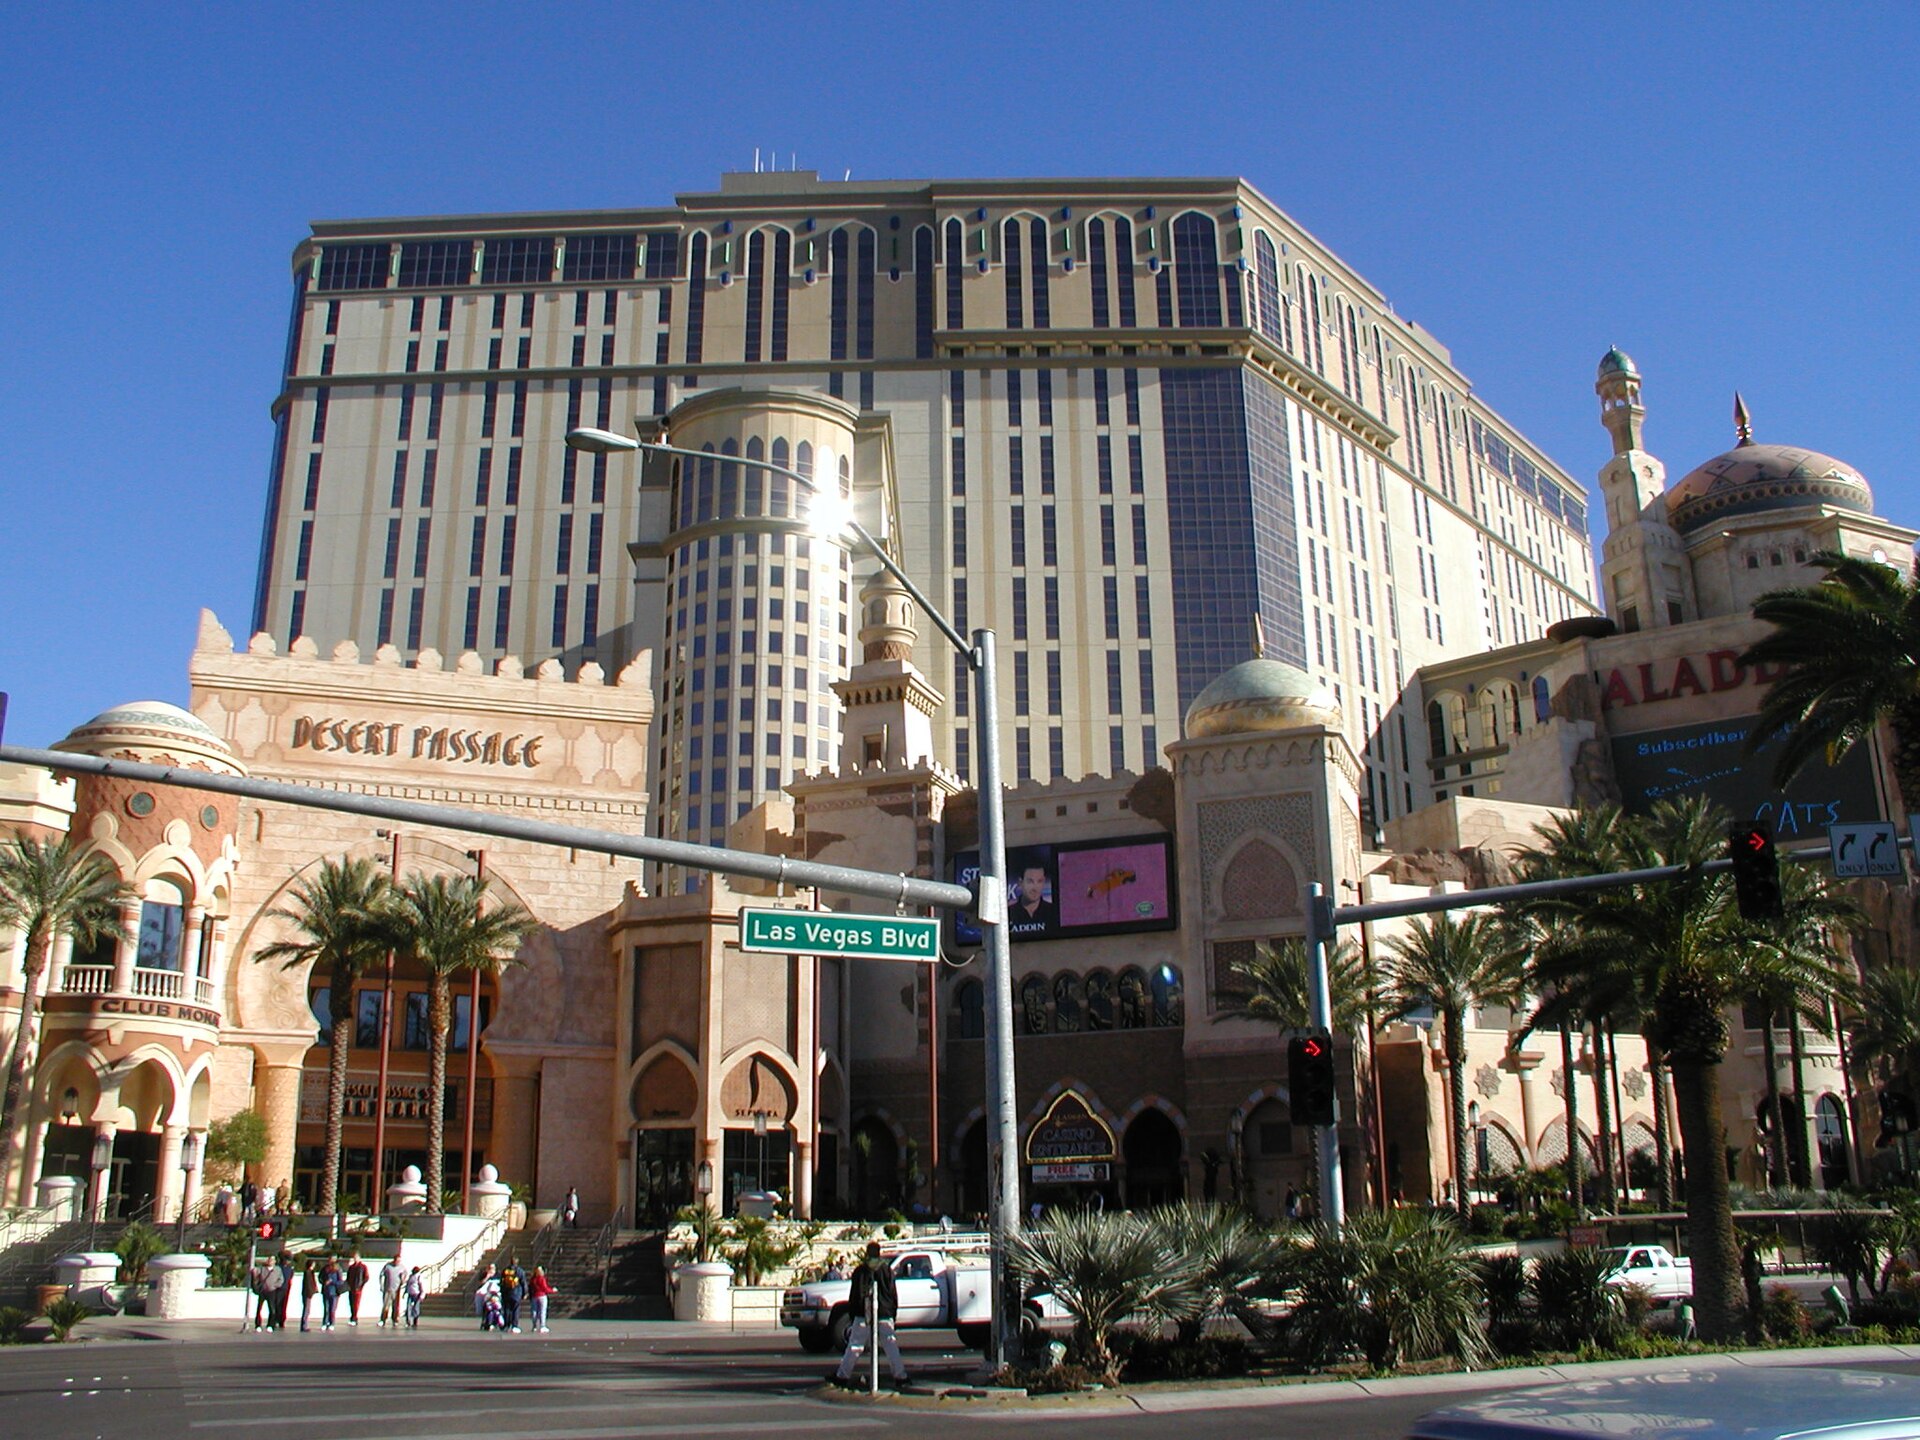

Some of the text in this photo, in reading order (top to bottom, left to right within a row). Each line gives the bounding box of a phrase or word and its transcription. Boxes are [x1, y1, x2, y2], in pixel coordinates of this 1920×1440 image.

[291, 715, 545, 769] DESERT PASSAGE
[1756, 800, 1842, 833] CATS
[1838, 862, 1895, 873] ONLY ONLY
[753, 919, 930, 950] Las Vegas Blvd
[101, 1000, 171, 1017] CLUB
